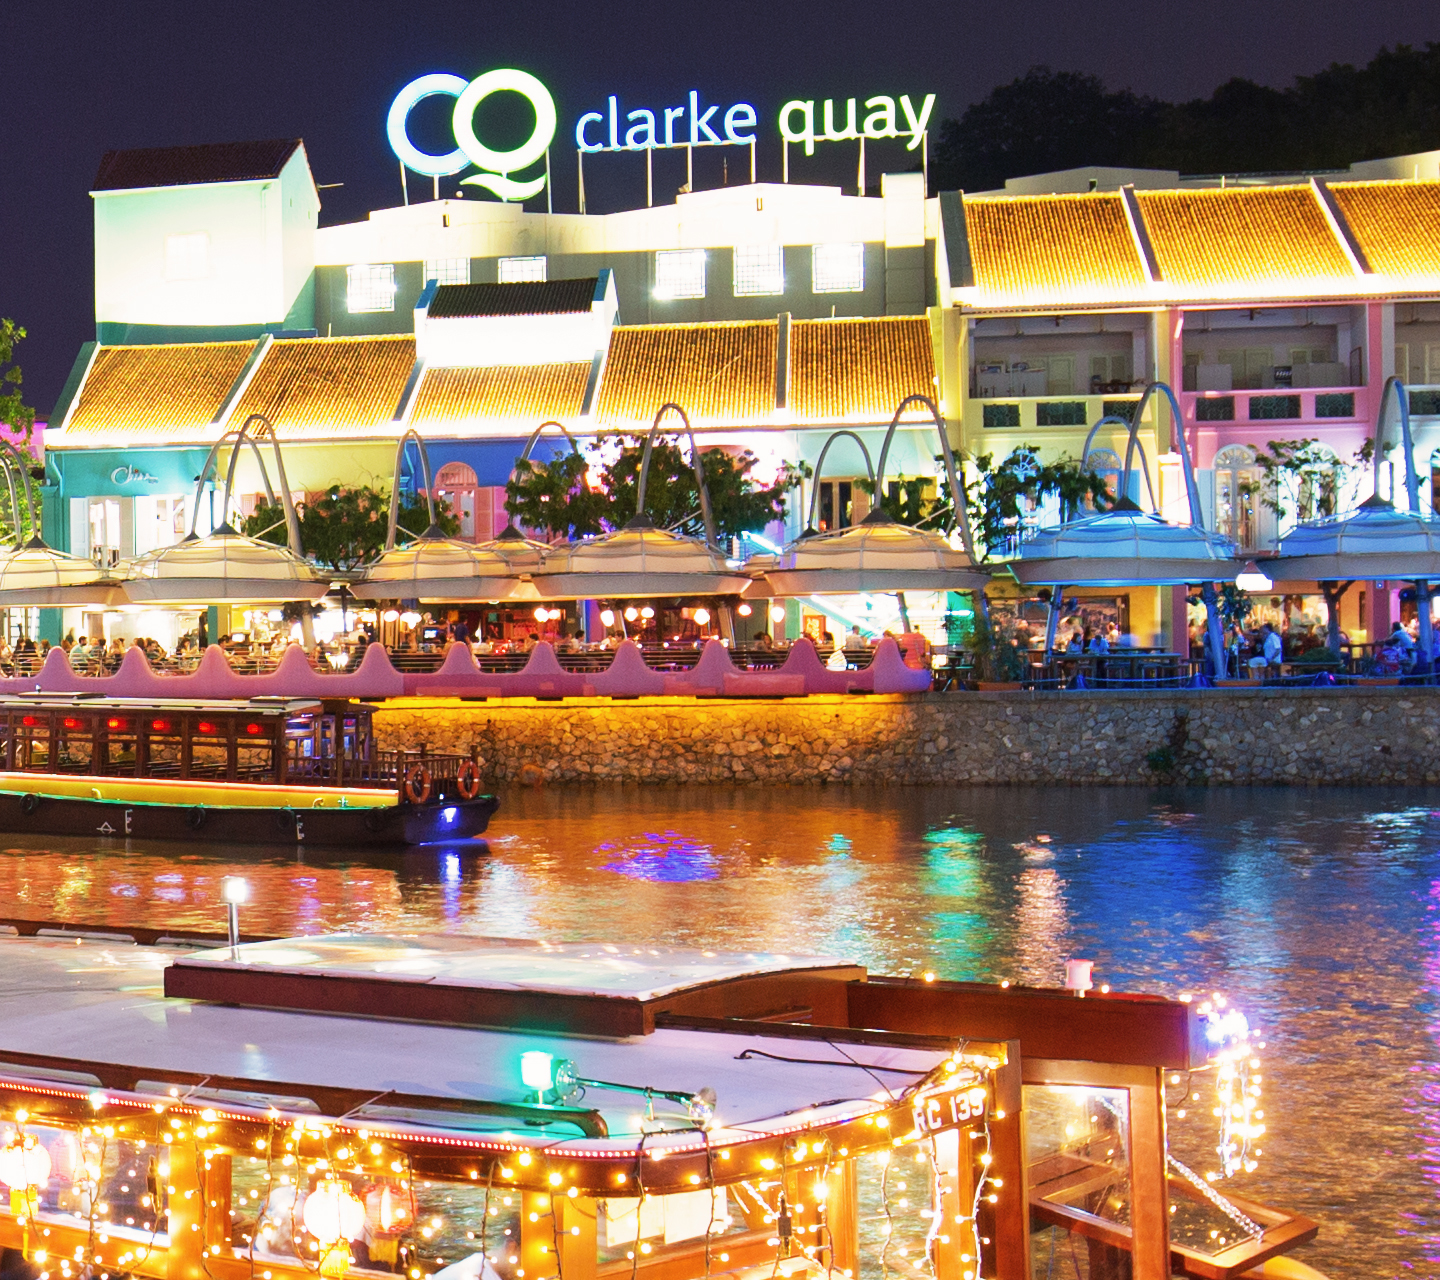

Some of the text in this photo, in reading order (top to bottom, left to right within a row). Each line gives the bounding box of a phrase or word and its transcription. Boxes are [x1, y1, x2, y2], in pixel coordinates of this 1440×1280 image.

[386, 68, 557, 201] CQ
[575, 90, 937, 156] clarke quay
[912, 1099, 942, 1133] RC
